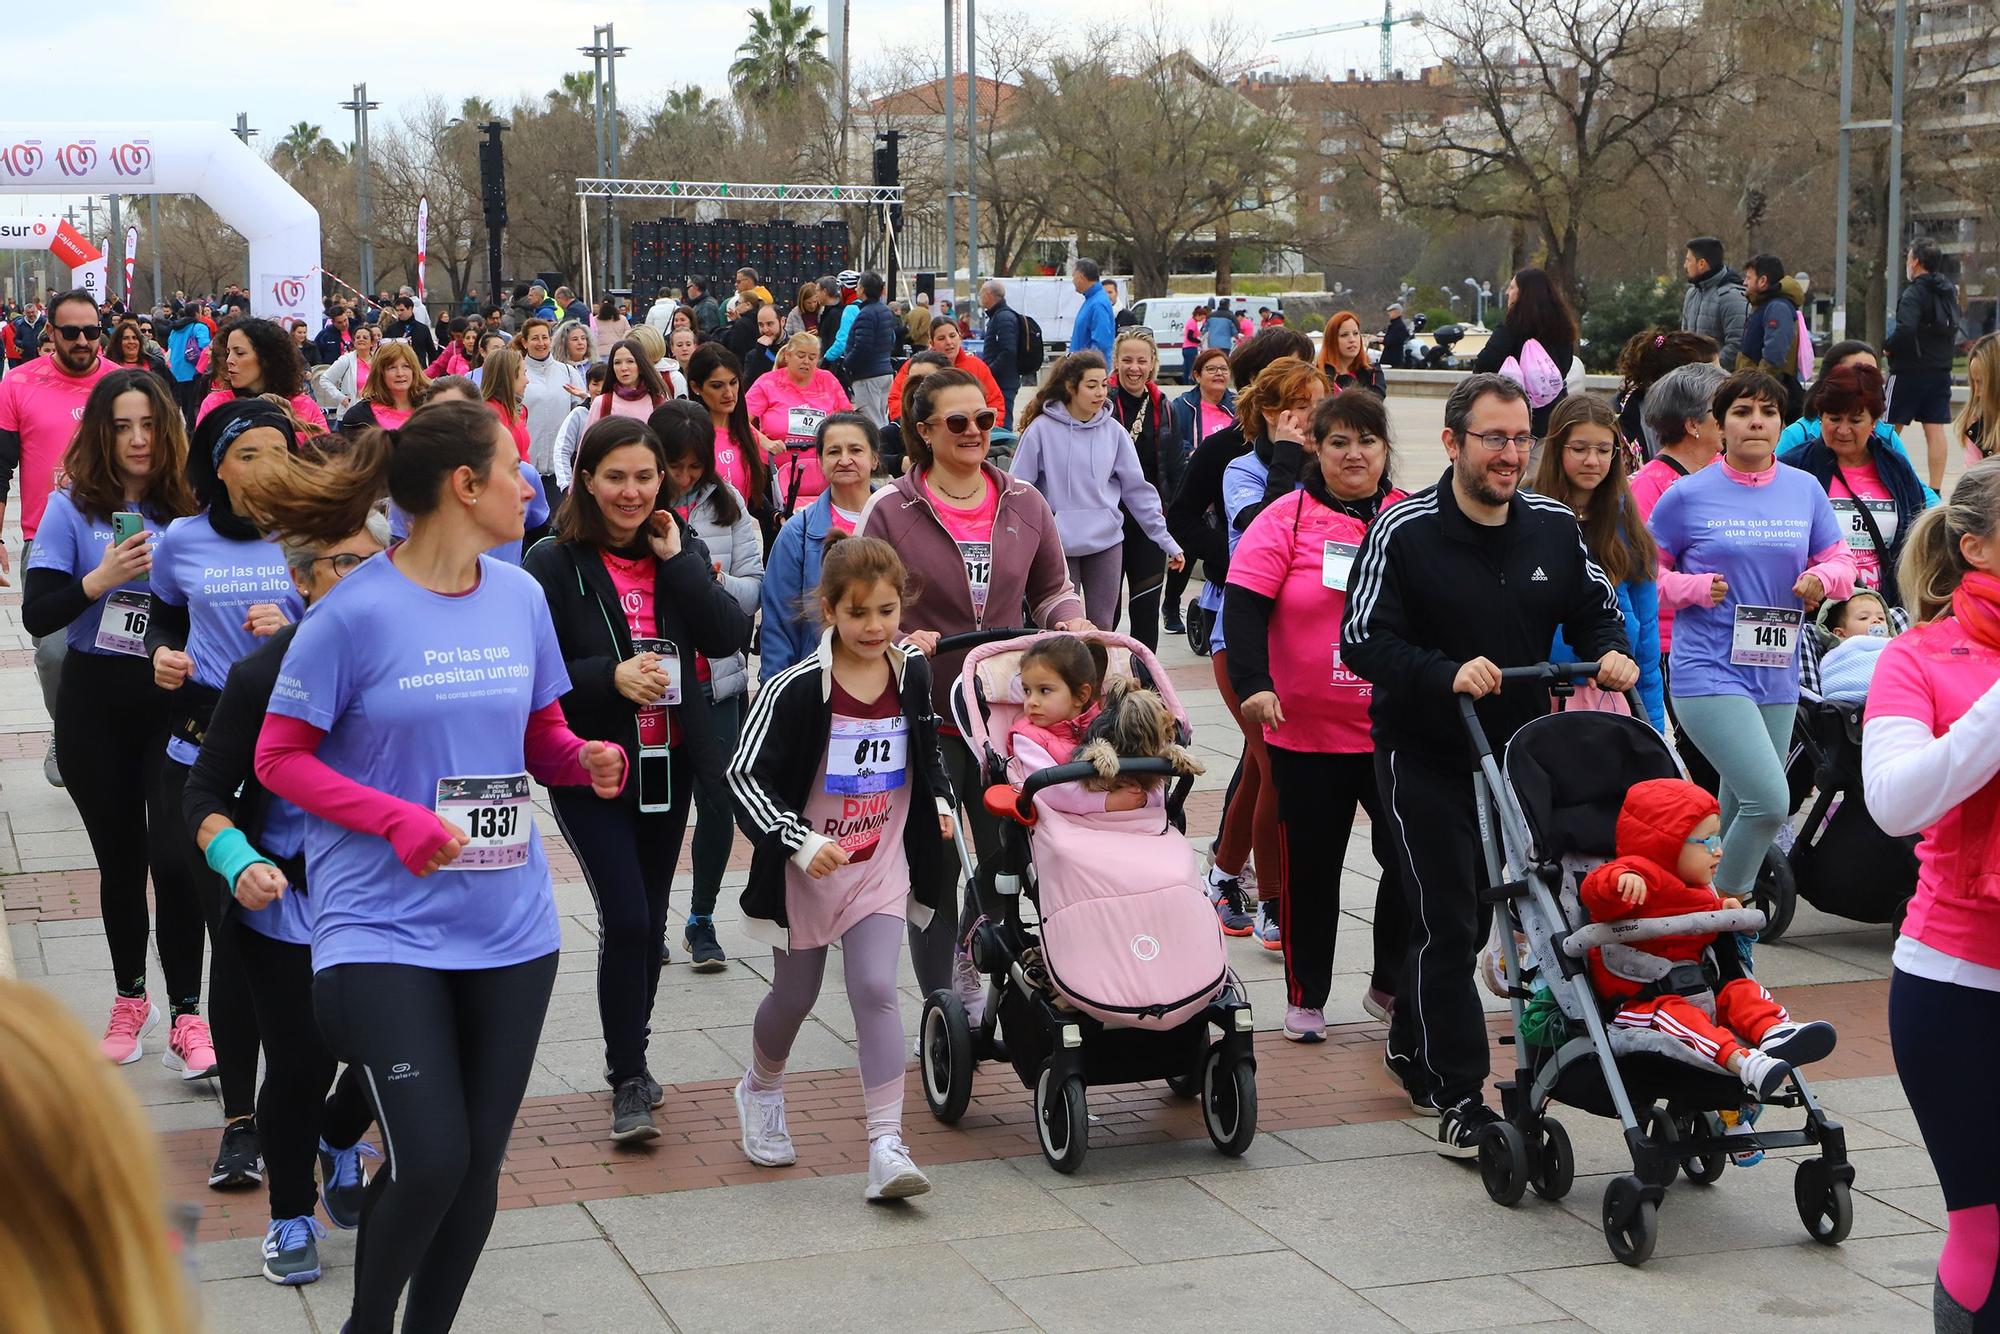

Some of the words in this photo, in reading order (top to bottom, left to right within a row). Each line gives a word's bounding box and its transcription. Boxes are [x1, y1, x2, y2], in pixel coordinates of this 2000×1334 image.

[57, 232, 85, 257] cajasur
[802, 416, 814, 427] 42
[1706, 519, 1726, 529] Por
[1729, 519, 1746, 527] las
[1747, 519, 1768, 529] que
[1770, 519, 1783, 528] se
[1784, 518, 1809, 528] creen
[1725, 529, 1746, 538] que
[1764, 529, 1803, 539] pueden
[204, 567, 229, 579] Por
[231, 565, 254, 577] las
[256, 564, 286, 578] que
[204, 580, 258, 594] sueñan
[261, 578, 290, 592] alto
[1754, 626, 1787, 648] 1416
[424, 649, 455, 666] Por
[456, 646, 482, 662] las
[483, 645, 511, 663] que
[398, 666, 486, 690] necesitan
[487, 666, 507, 680] un
[508, 662, 530, 678] reto
[854, 738, 891, 765] 812
[843, 791, 891, 820] PINK
[467, 805, 518, 839] 1337
[1611, 924, 1639, 933] tuctuc
